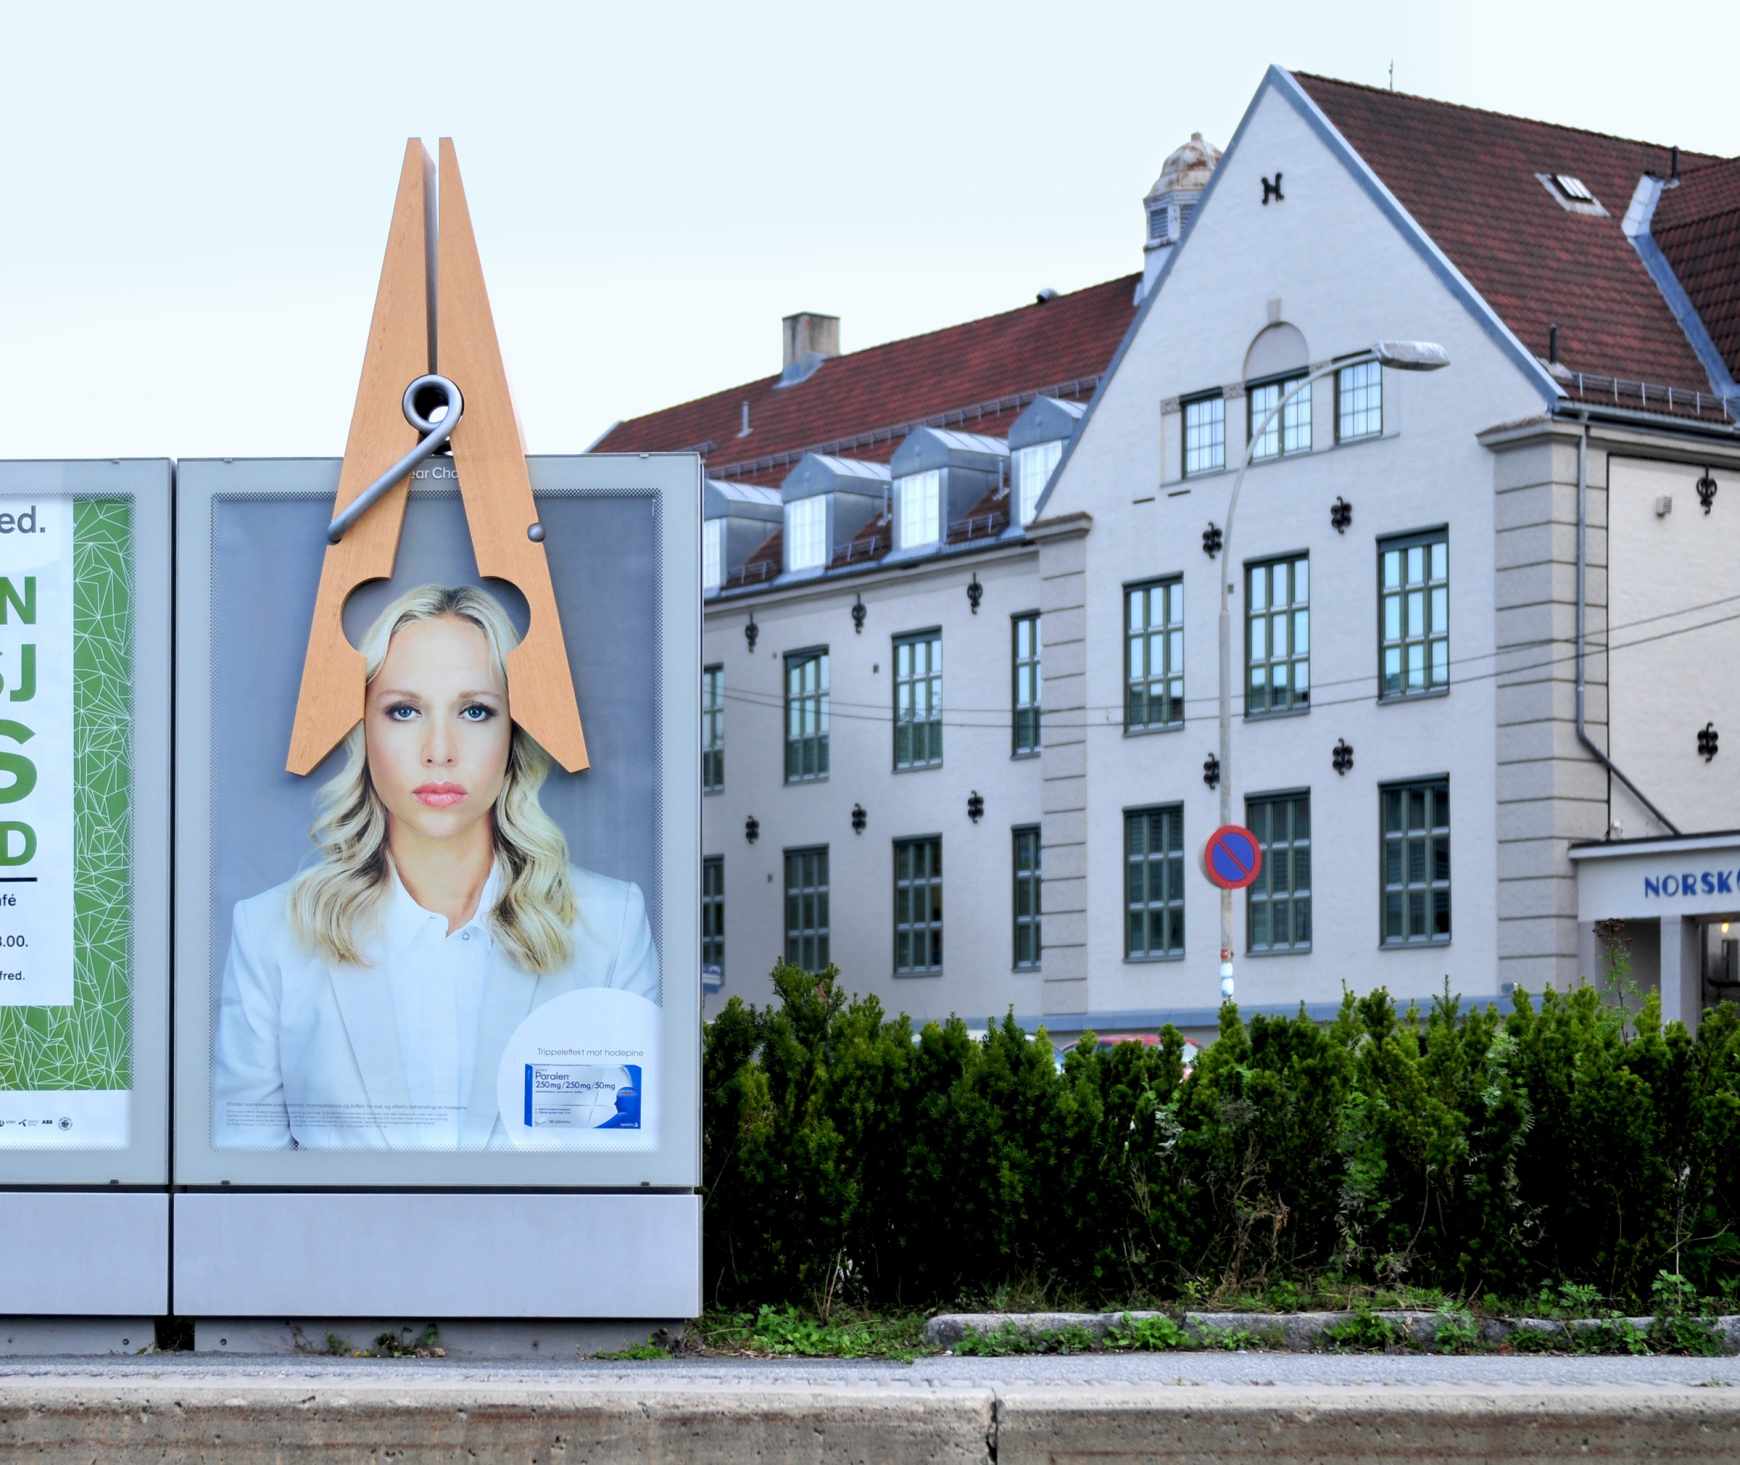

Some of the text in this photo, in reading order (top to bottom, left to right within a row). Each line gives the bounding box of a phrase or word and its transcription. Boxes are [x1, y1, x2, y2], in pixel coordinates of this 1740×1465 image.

[0, 643, 37, 702] J
[1643, 868, 1740, 899] NORSK
[0, 893, 17, 907] fé
[604, 1047, 645, 1060] hodepine
